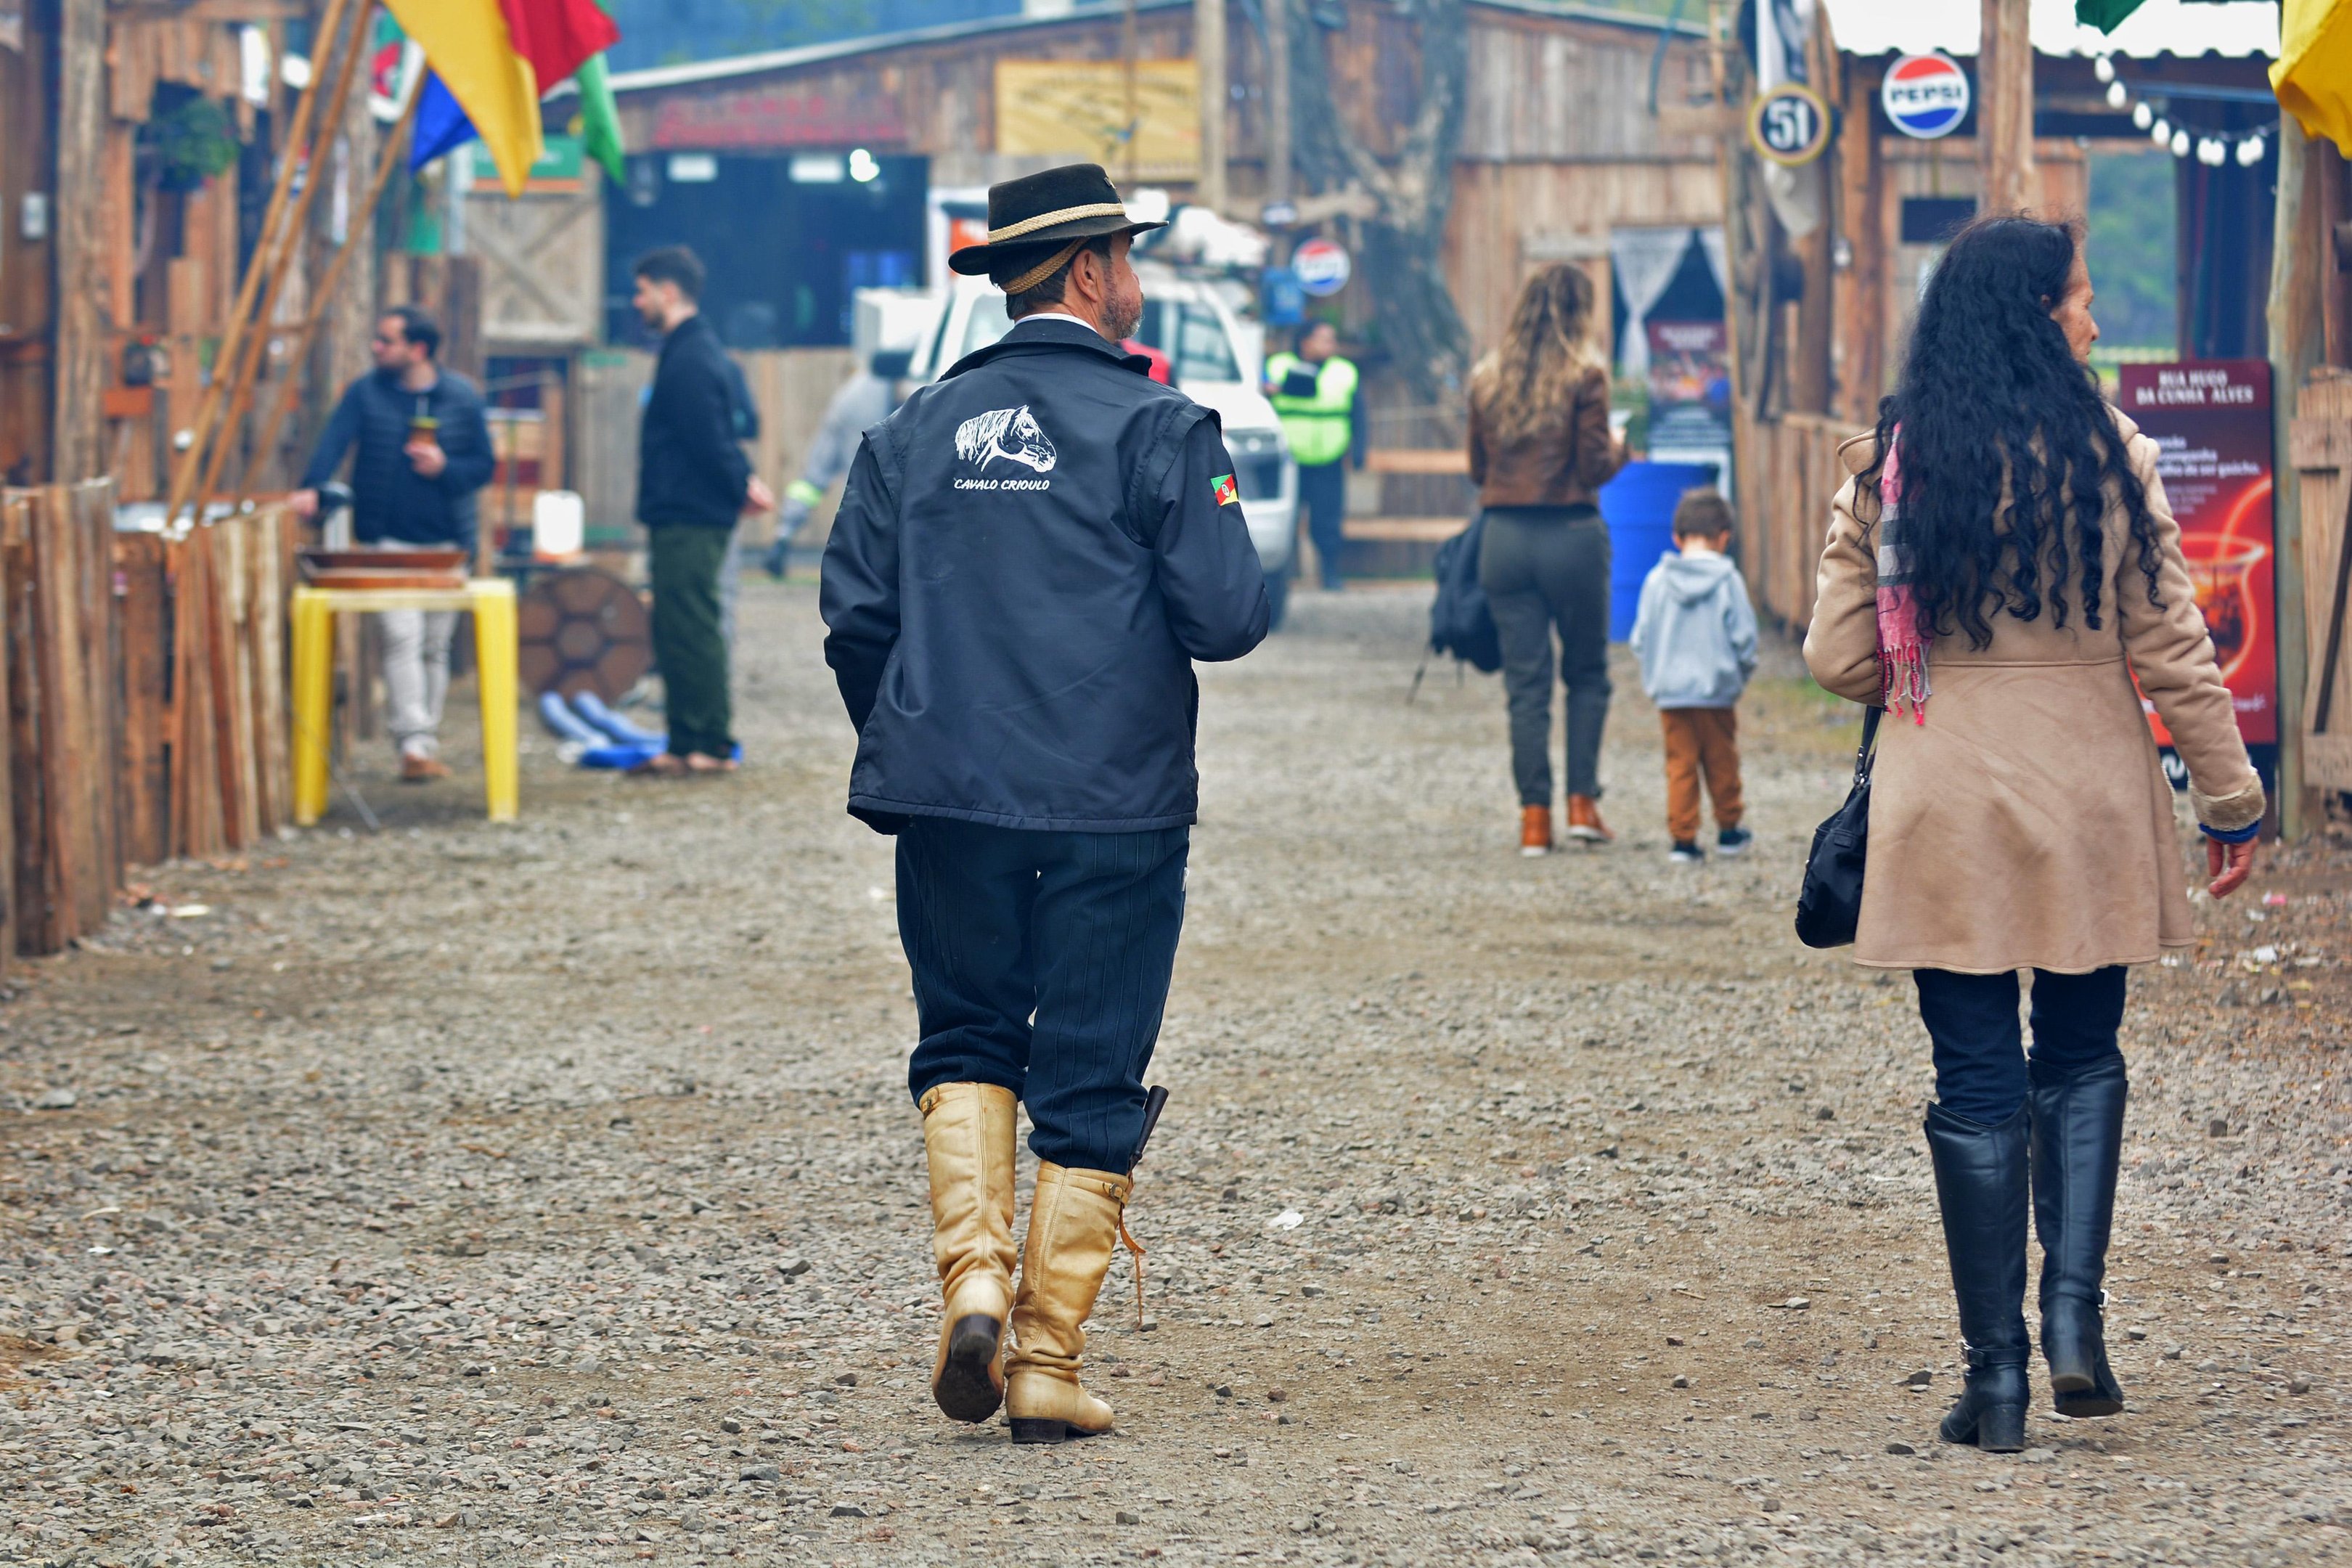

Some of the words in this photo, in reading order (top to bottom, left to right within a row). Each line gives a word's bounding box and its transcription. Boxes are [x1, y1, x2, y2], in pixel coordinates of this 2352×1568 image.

[1890, 86, 1961, 102] PEPSI
[1768, 99, 1809, 149] 51
[2159, 370, 2186, 386] RUA
[2189, 370, 2227, 386] HUGO
[2136, 387, 2155, 405] DA
[2157, 387, 2205, 404] CUNHA
[2211, 385, 2253, 403] ALVES
[954, 478, 998, 490] CAVALO
[1000, 479, 1050, 491] CRIOULO
